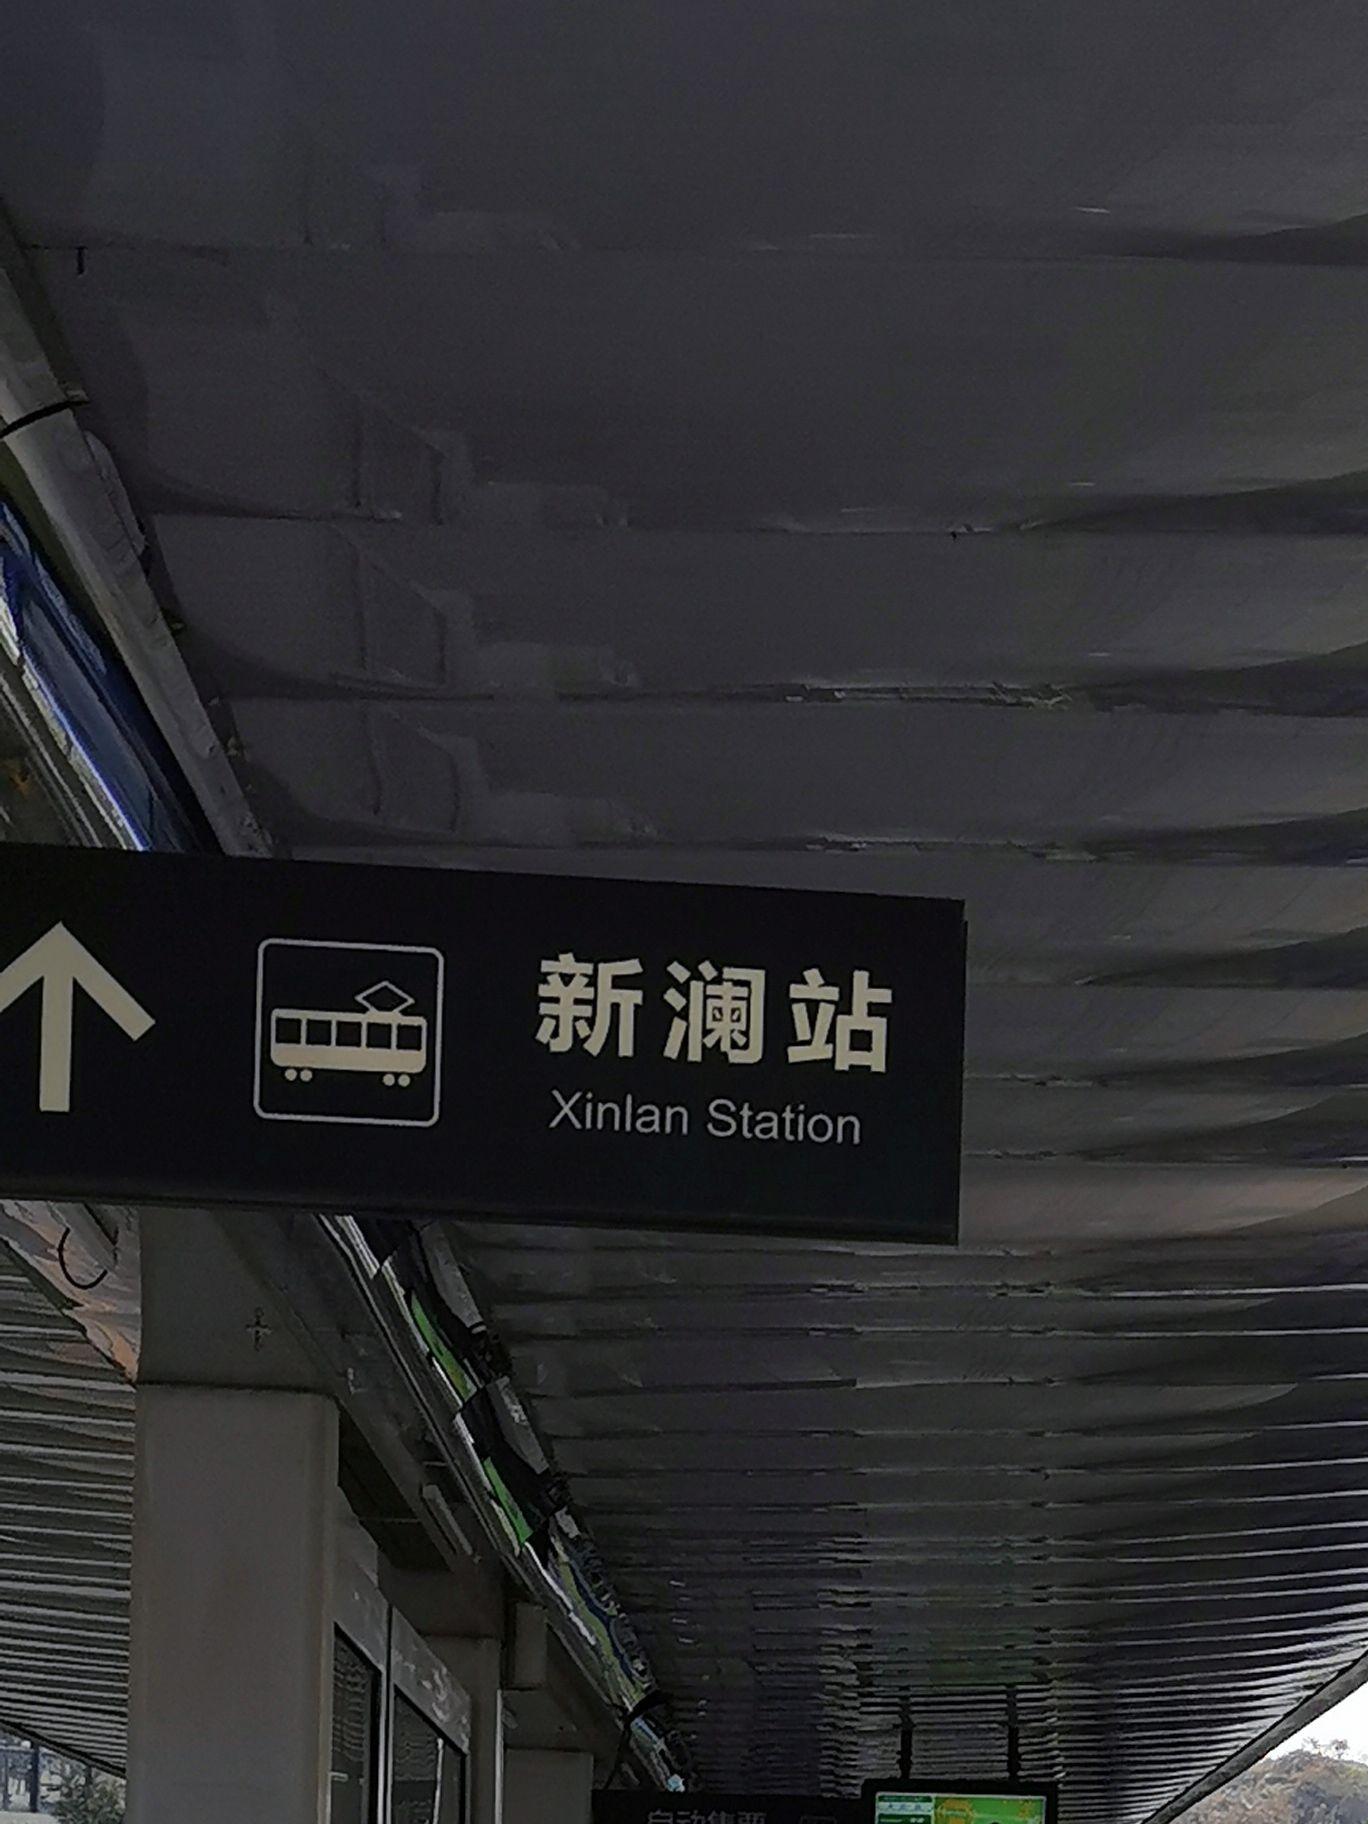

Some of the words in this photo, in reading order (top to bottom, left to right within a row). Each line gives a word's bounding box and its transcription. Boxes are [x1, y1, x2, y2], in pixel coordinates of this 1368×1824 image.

[534, 951, 893, 1073] 新澜站
[549, 1090, 690, 1136] Xinlan
[706, 1099, 862, 1146] Station
